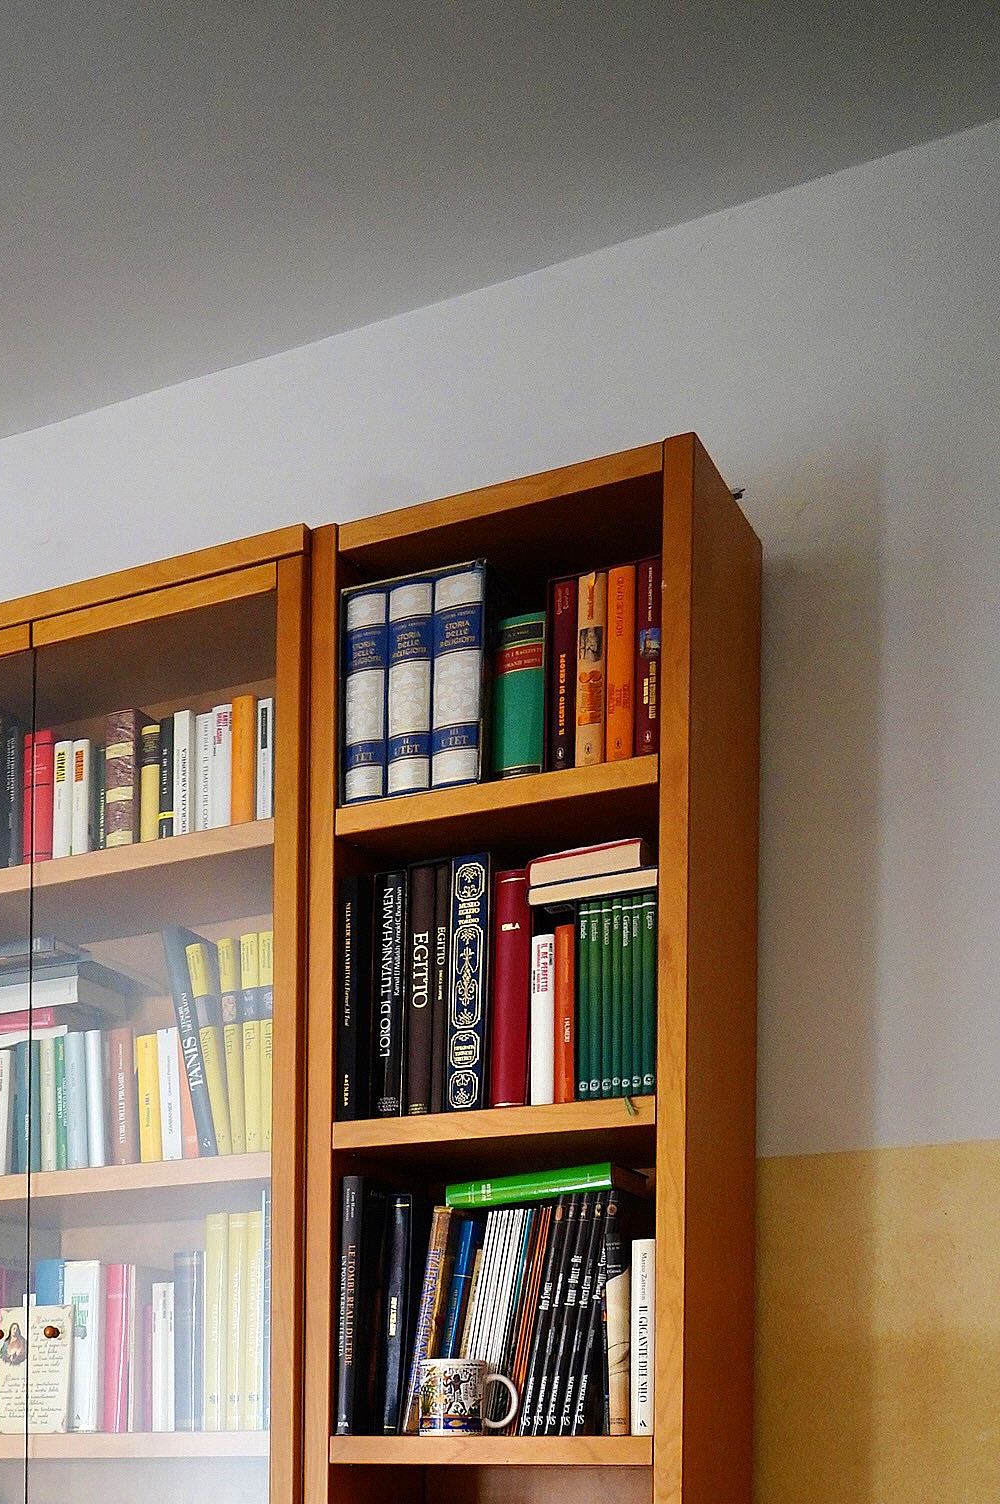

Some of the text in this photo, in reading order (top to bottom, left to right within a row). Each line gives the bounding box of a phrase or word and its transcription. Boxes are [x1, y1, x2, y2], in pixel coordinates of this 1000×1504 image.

[444, 619, 470, 631] STORIA
[559, 652, 567, 684] CHEOPE
[559, 685, 566, 695] DI
[558, 728, 566, 736] IL
[436, 926, 446, 966] EGITTO
[540, 951, 549, 959] RE
[380, 888, 394, 1057] L'ORO DI TUTANKHAMEN
[412, 930, 429, 1008] EGITTO
[540, 962, 549, 992] PERFETTO
[183, 1036, 204, 1092] TANIS
[346, 1244, 356, 1254] LE
[346, 1256, 355, 1294] TOMBE
[345, 1328, 354, 1338] DI
[637, 1305, 648, 1403] IL GIGANTE DEL NILO
